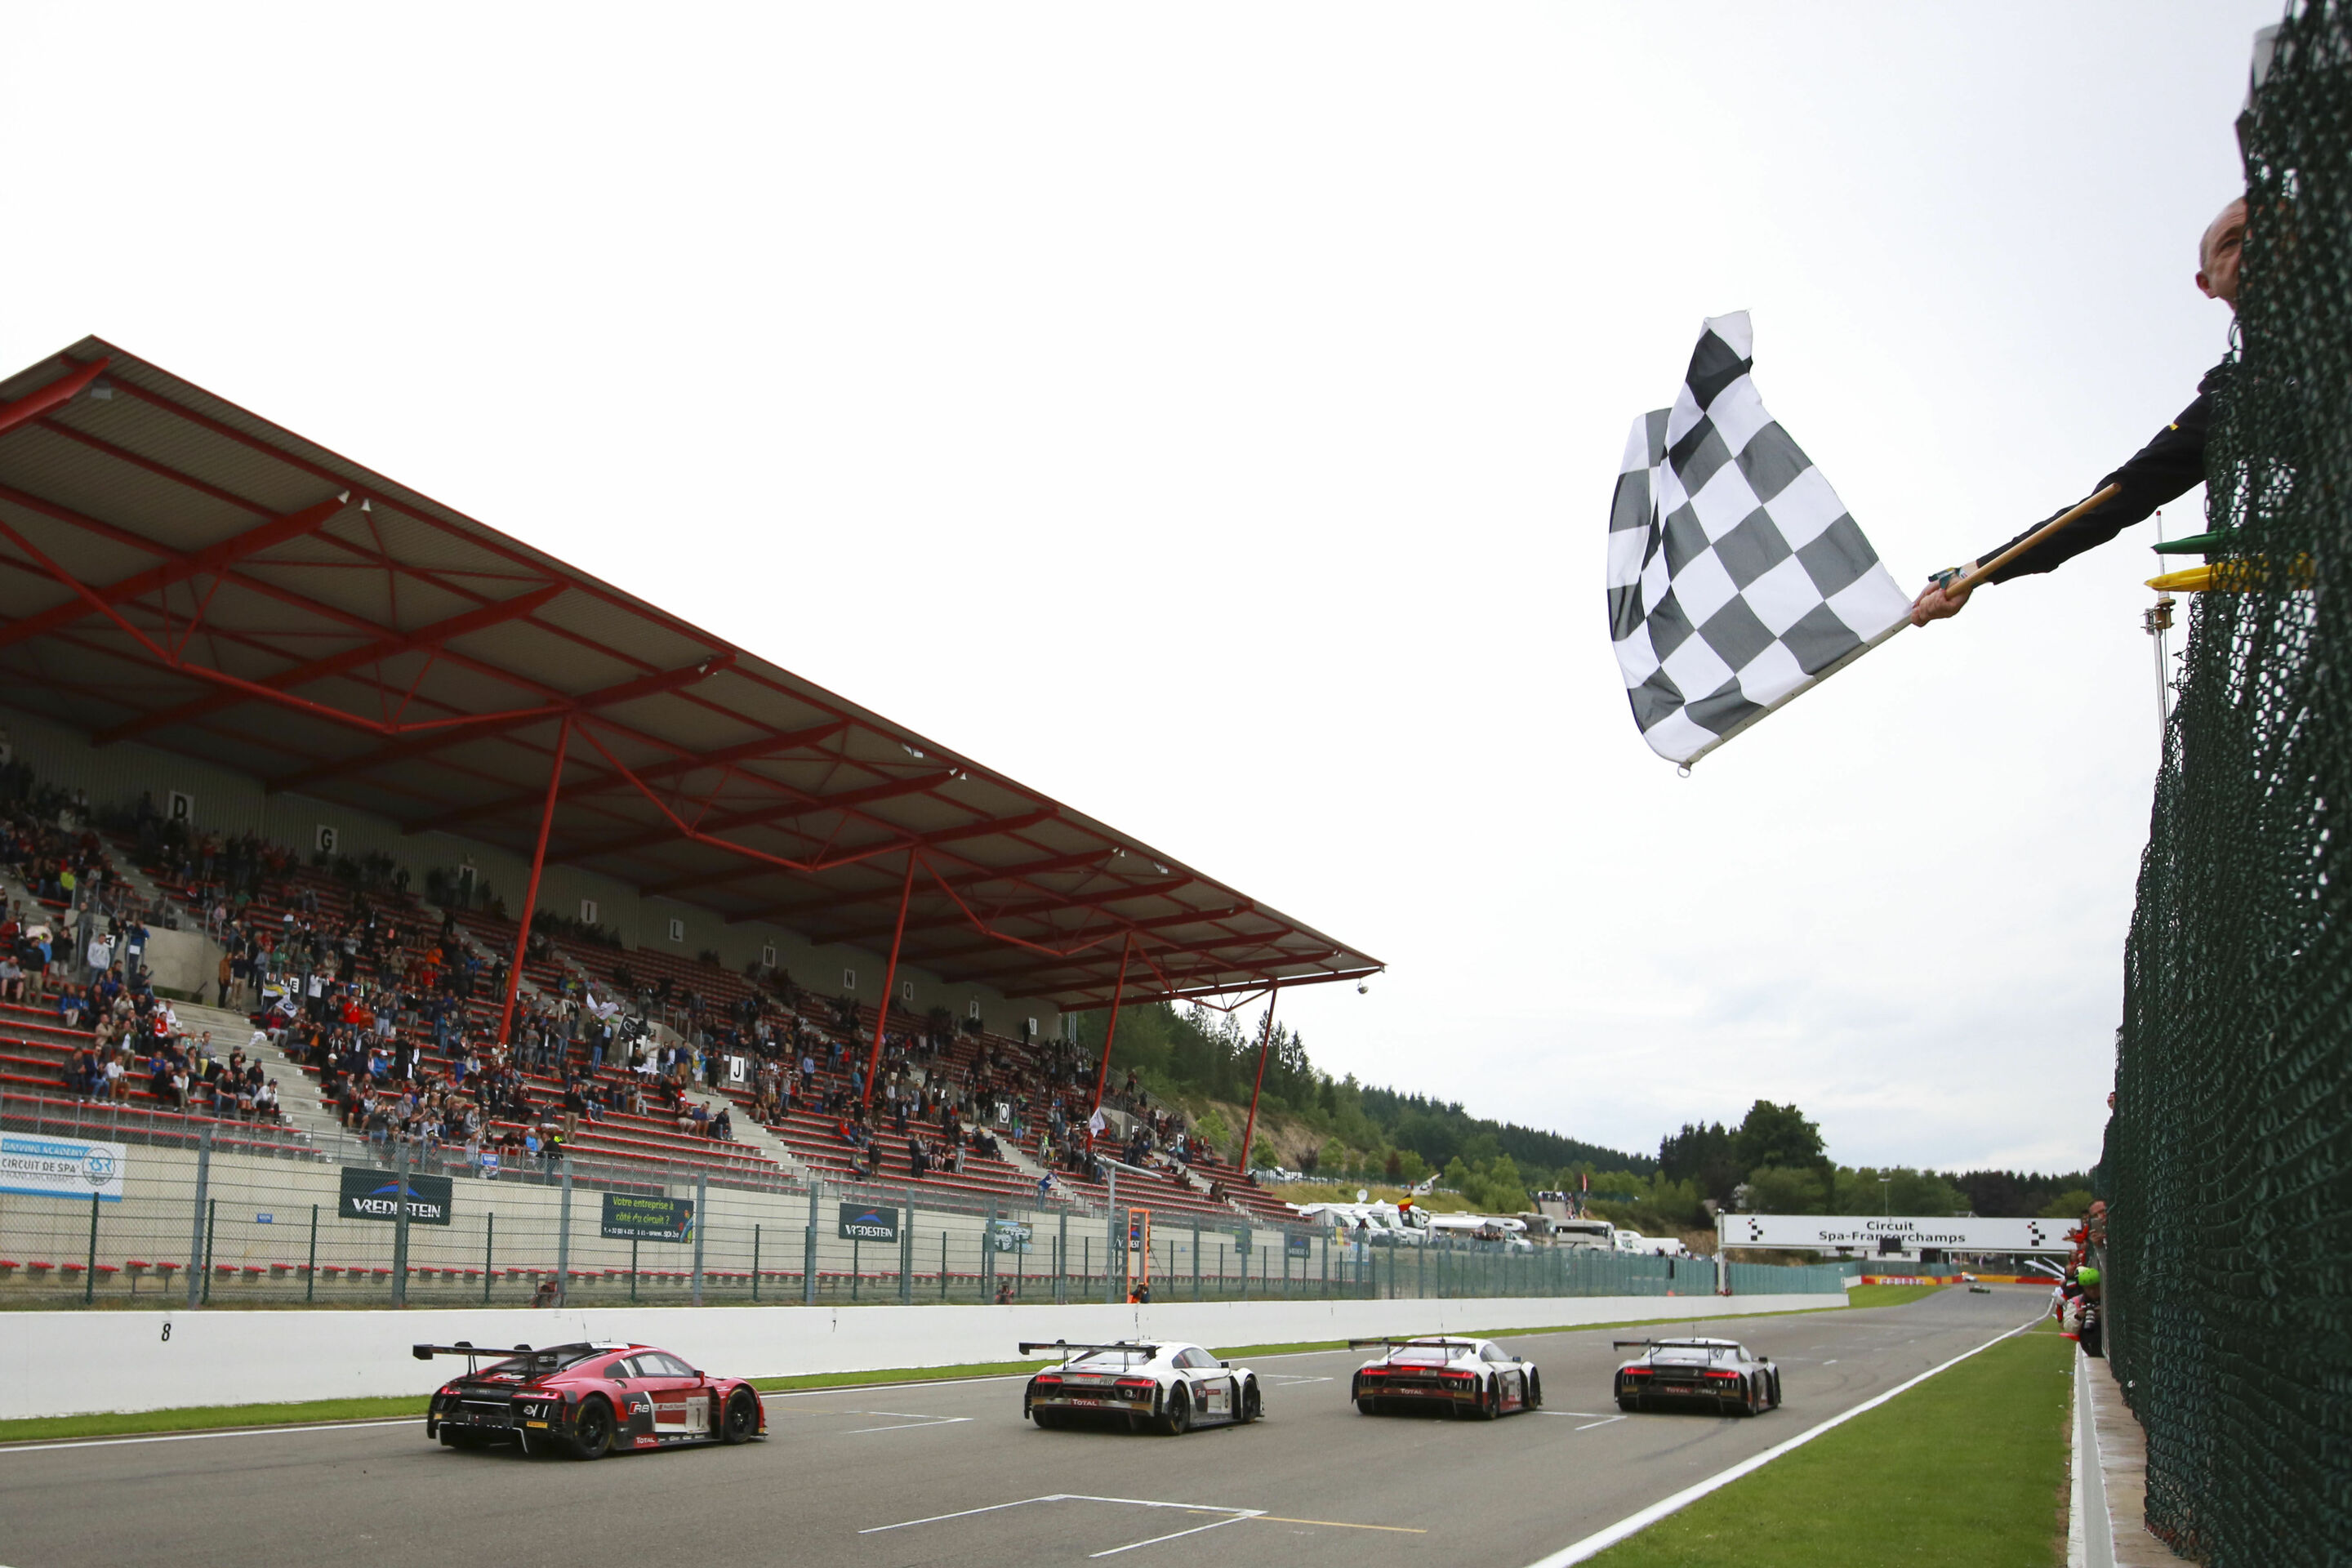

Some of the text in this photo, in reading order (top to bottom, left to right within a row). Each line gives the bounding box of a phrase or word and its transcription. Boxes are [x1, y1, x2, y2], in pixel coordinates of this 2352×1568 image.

[172, 795, 188, 819] D
[321, 828, 332, 850] G
[672, 921, 679, 939] L
[765, 947, 773, 964] M
[845, 971, 853, 987] N
[905, 982, 911, 999] Q
[733, 1060, 741, 1078] J
[1001, 1104, 1008, 1122] O
[2, 1158, 76, 1174] CIRCUIT DE SPA
[352, 1197, 441, 1218] VREDSTEIN
[612, 1196, 632, 1207] Votre
[633, 1199, 668, 1211] entreprise
[1866, 1220, 1914, 1232] Circuit
[161, 1323, 172, 1342] 8
[633, 1404, 650, 1414] R8
[1072, 1398, 1098, 1406] TOTAL
